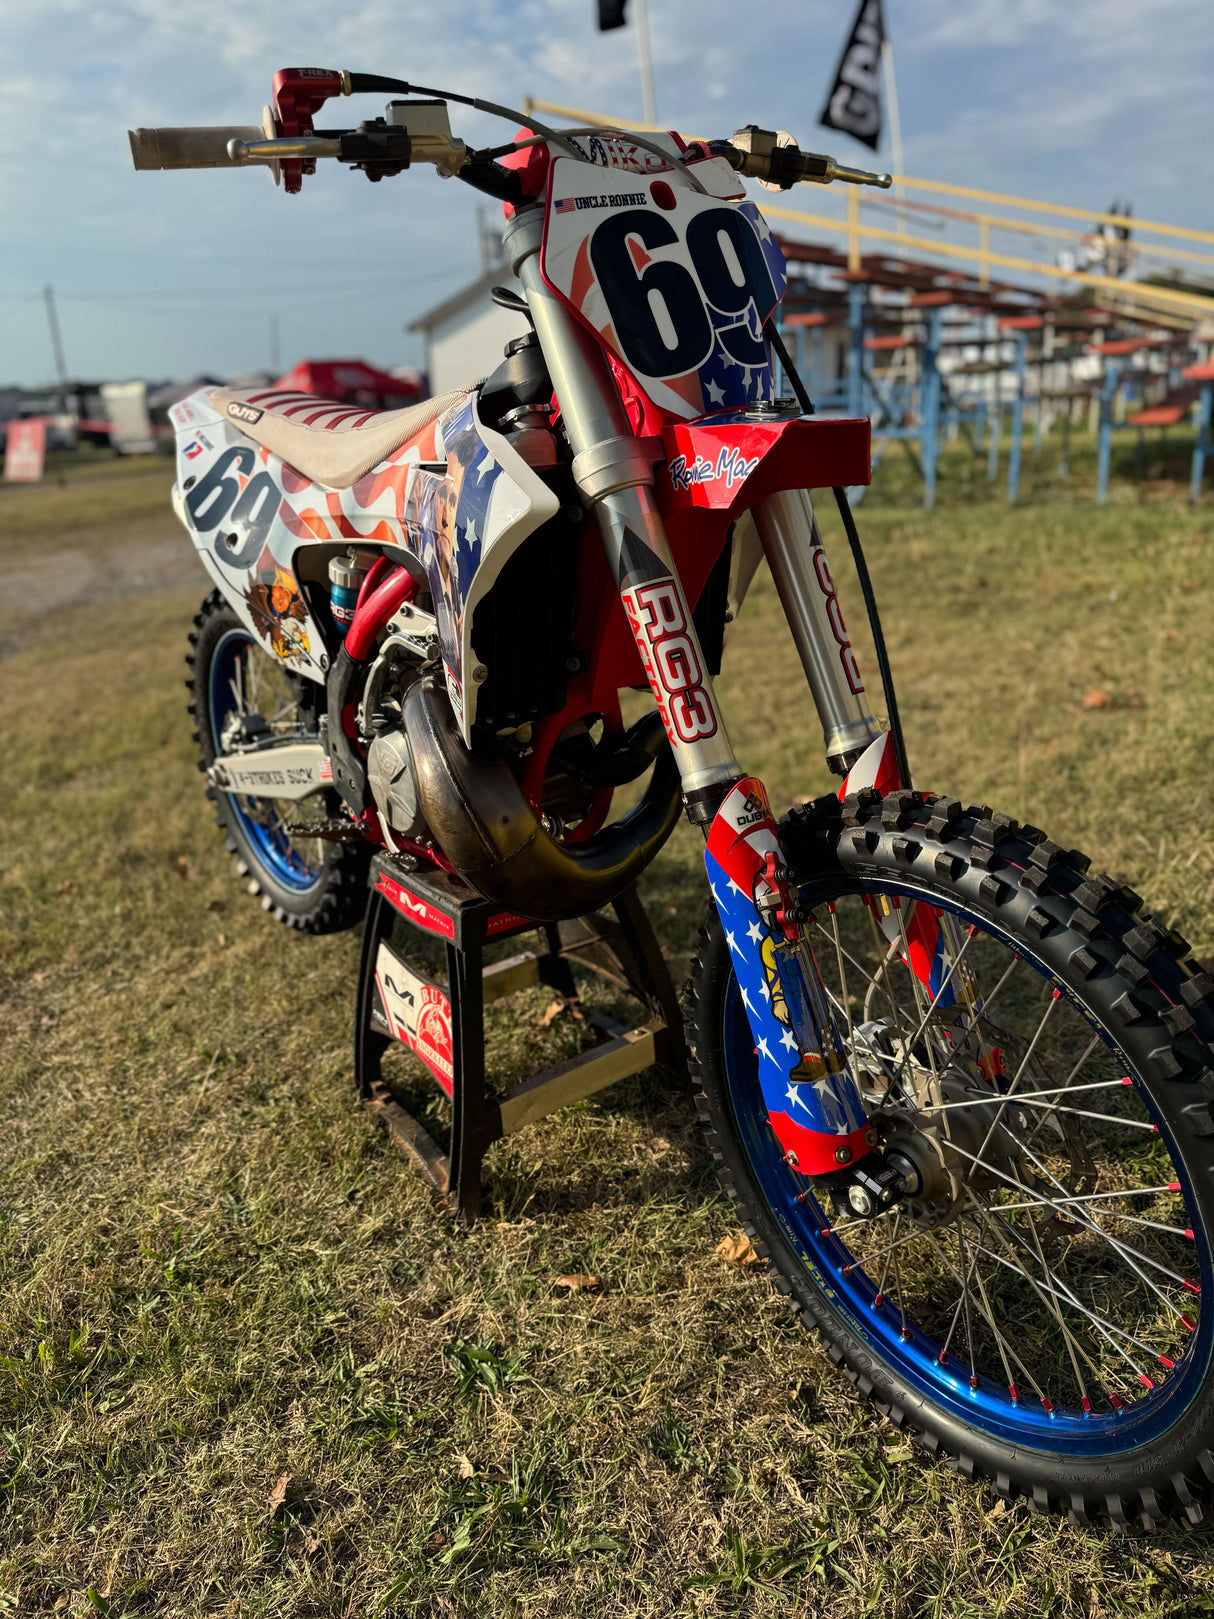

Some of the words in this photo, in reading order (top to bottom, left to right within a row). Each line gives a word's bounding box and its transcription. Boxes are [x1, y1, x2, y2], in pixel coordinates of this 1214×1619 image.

[574, 195, 608, 210] UNCLE
[610, 192, 648, 207] RONNIE
[589, 207, 777, 379] 69
[228, 403, 260, 421] GUTS
[186, 446, 282, 570] 69
[621, 595, 678, 748] FACTORY
[634, 579, 718, 744] RG3
[287, 768, 313, 785] SUCK
[428, 913, 450, 930] MATRIX
[421, 988, 449, 1011] BUT
[791, 1274, 895, 1388] DUNLOP
